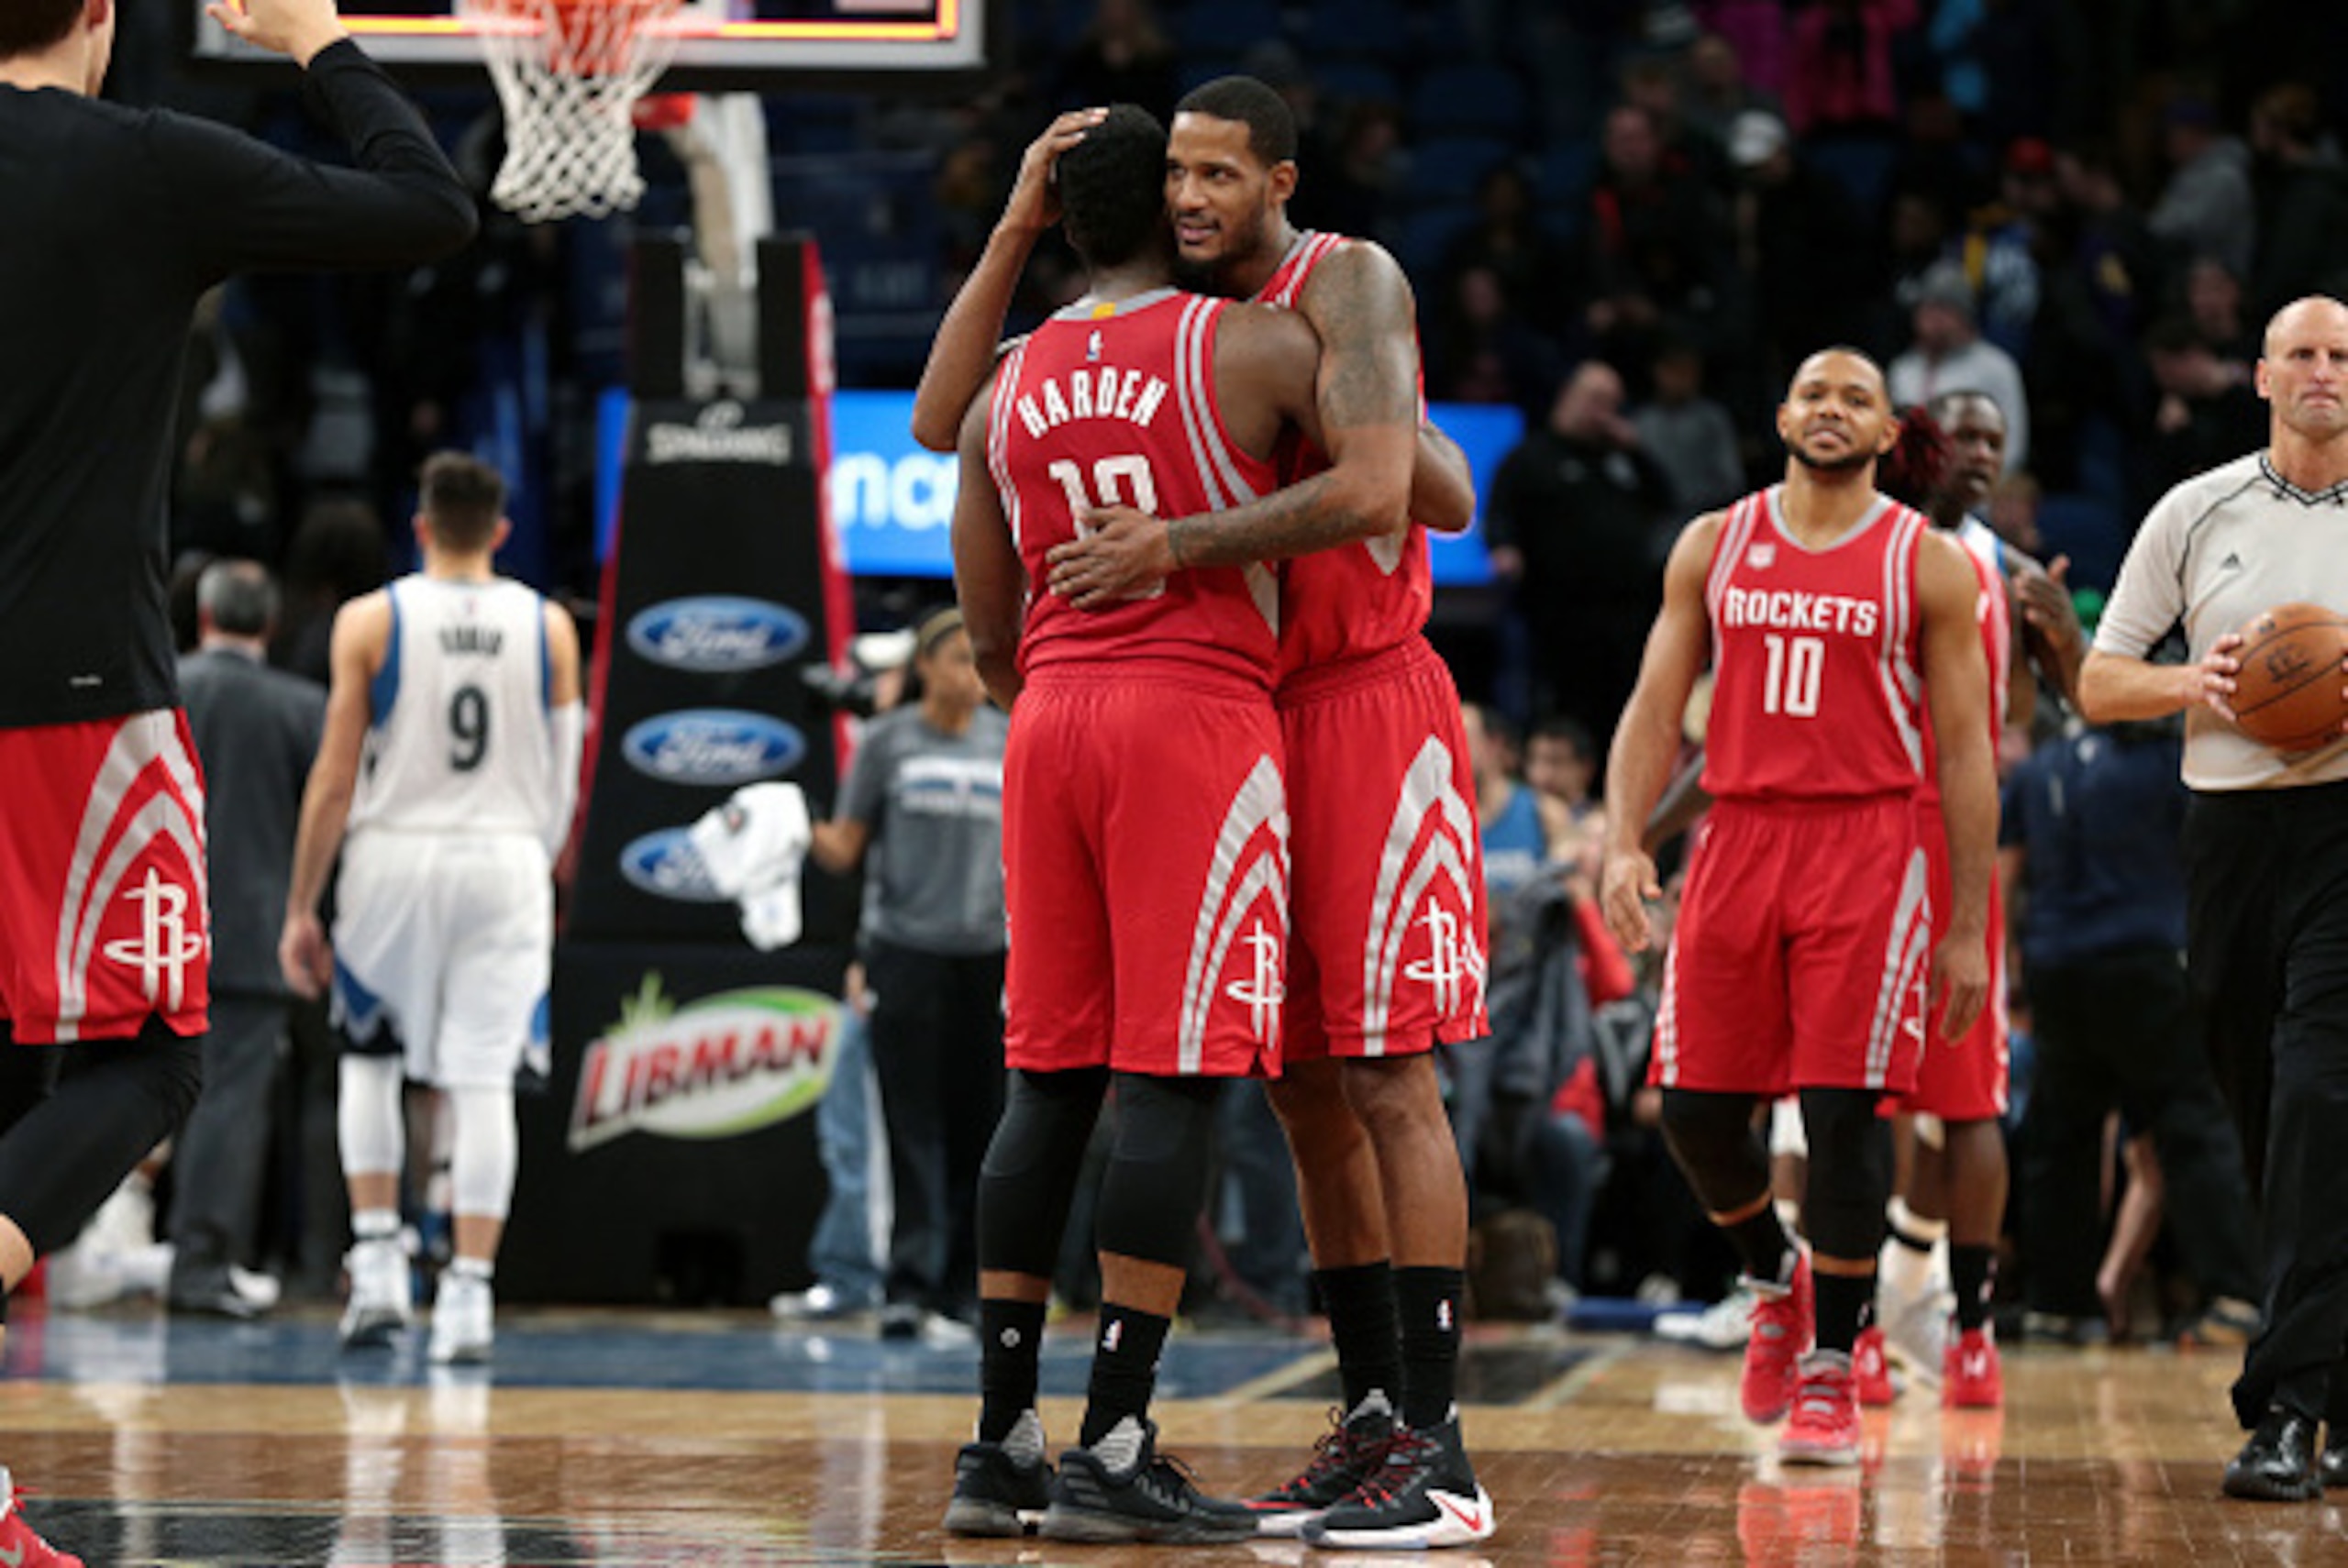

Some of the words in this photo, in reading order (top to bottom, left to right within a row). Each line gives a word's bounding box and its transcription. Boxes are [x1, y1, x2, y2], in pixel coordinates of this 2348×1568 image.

[1016, 366, 1169, 439] HARDEN
[659, 615, 773, 661] Ford
[1724, 585, 1877, 636] ROCKETS
[1764, 634, 1825, 718] 10
[449, 685, 490, 772] 9
[654, 725, 768, 772] Ford
[584, 1016, 829, 1128] LIBMAN
